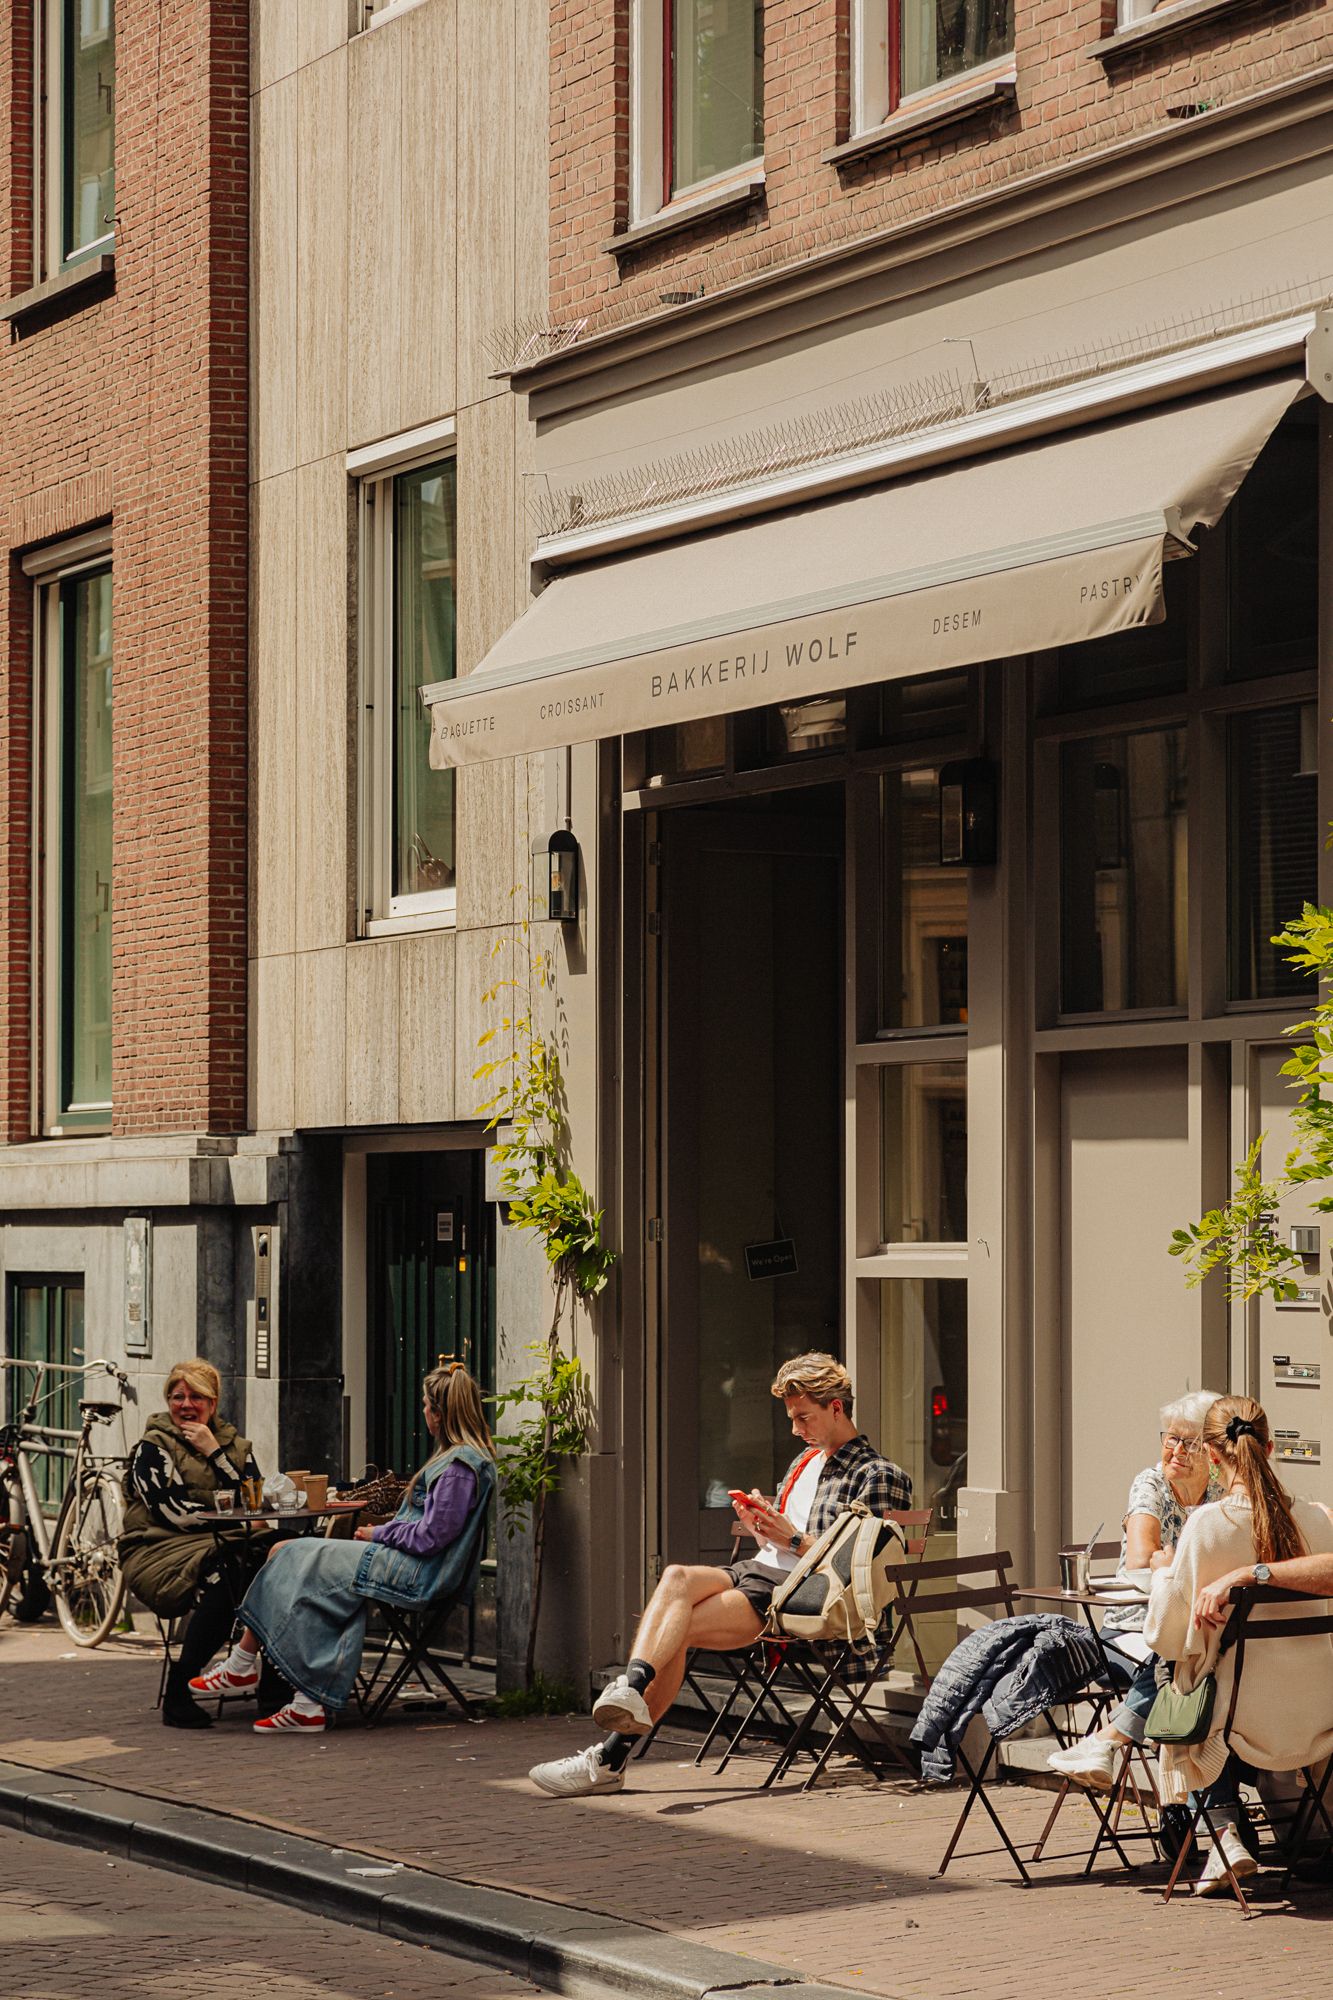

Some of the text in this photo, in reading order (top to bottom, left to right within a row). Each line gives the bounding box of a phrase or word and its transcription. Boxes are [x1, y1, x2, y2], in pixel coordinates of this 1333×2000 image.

[932, 609, 982, 635] DESEM
[651, 631, 858, 697] BAKKERIJ WOLF
[539, 692, 605, 720] CROISSANT
[440, 716, 496, 740] BAGUETTE
